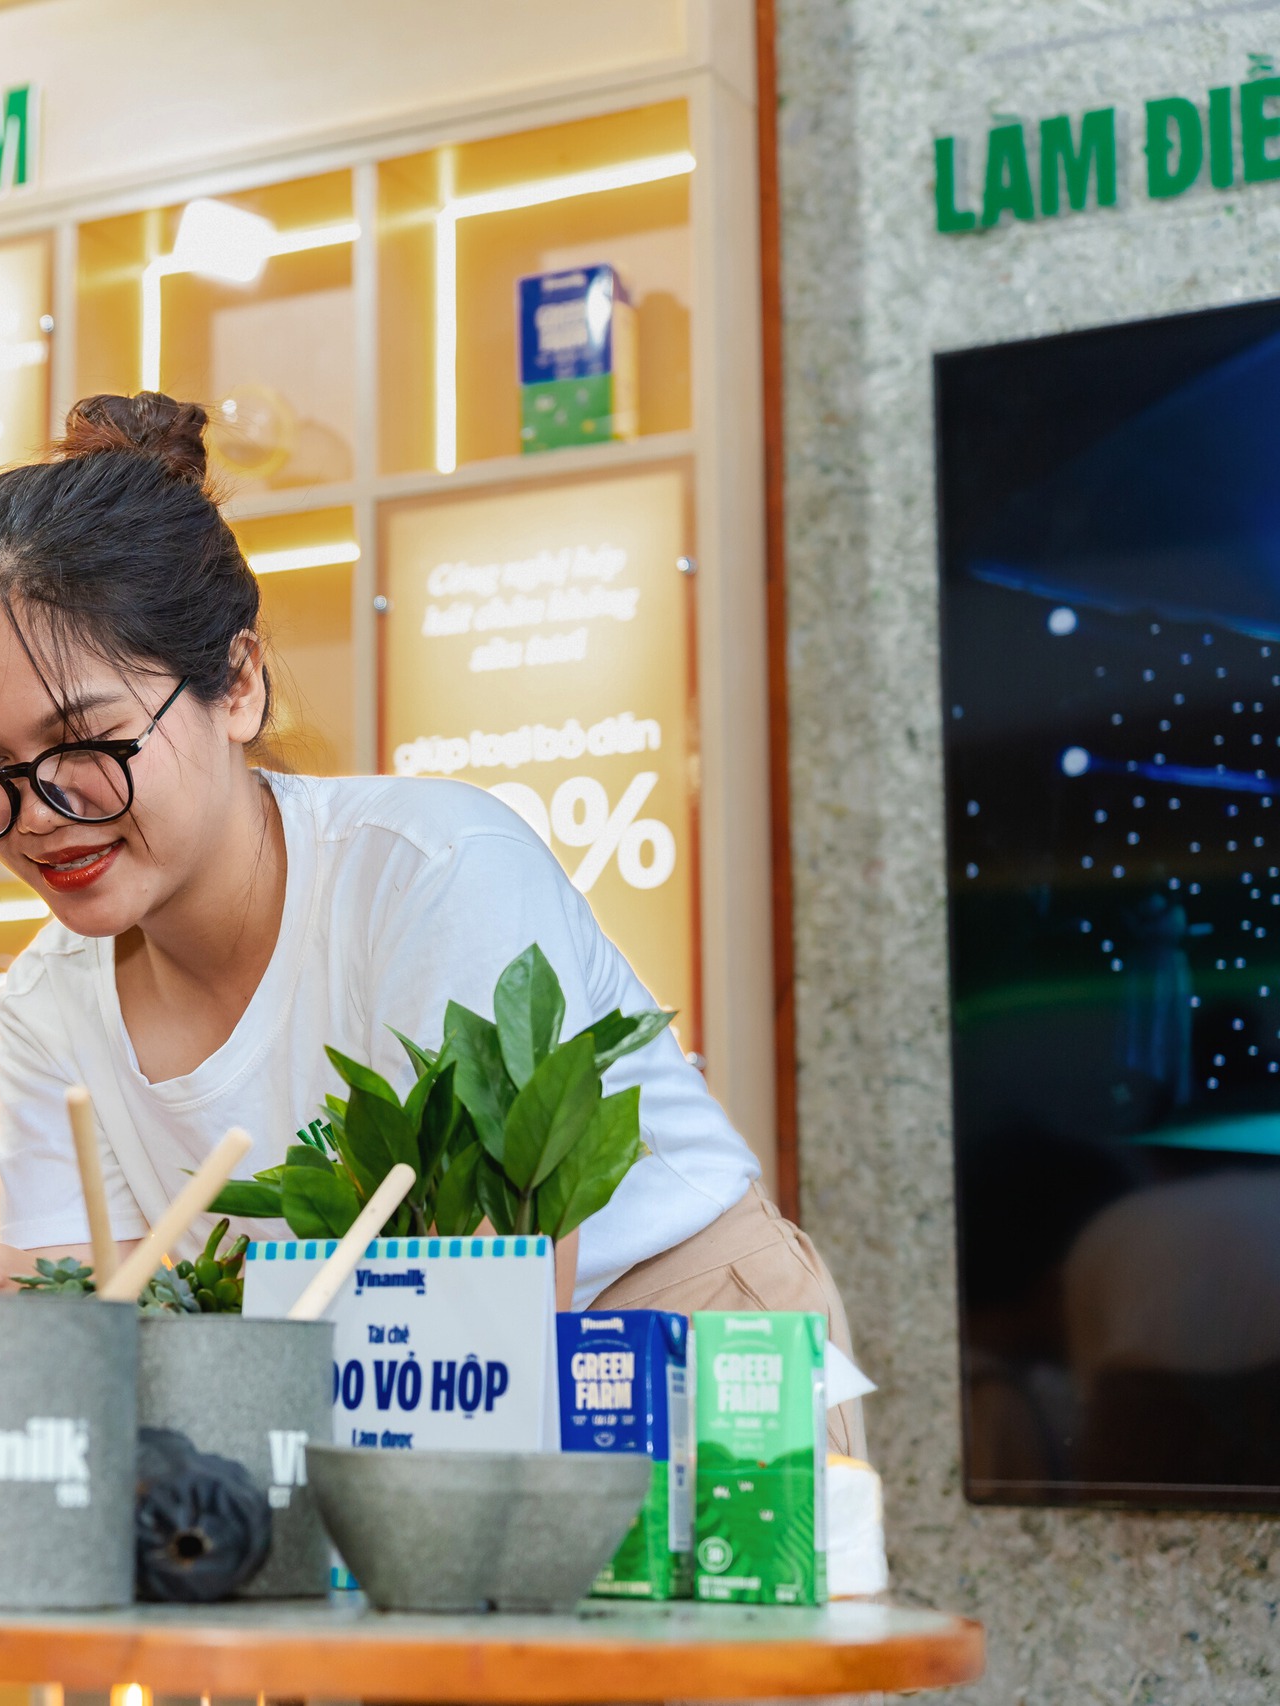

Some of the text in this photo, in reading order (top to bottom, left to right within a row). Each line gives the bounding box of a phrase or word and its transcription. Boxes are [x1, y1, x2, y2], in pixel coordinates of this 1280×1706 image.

[355, 1269, 426, 1295] Vinamilk
[571, 1352, 635, 1381] GREEN
[713, 1353, 783, 1382] GREEN
[373, 1351, 423, 1412] VỎ
[431, 1353, 509, 1419] HỘP
[576, 1380, 632, 1410] FARM
[718, 1383, 779, 1412] FARM
